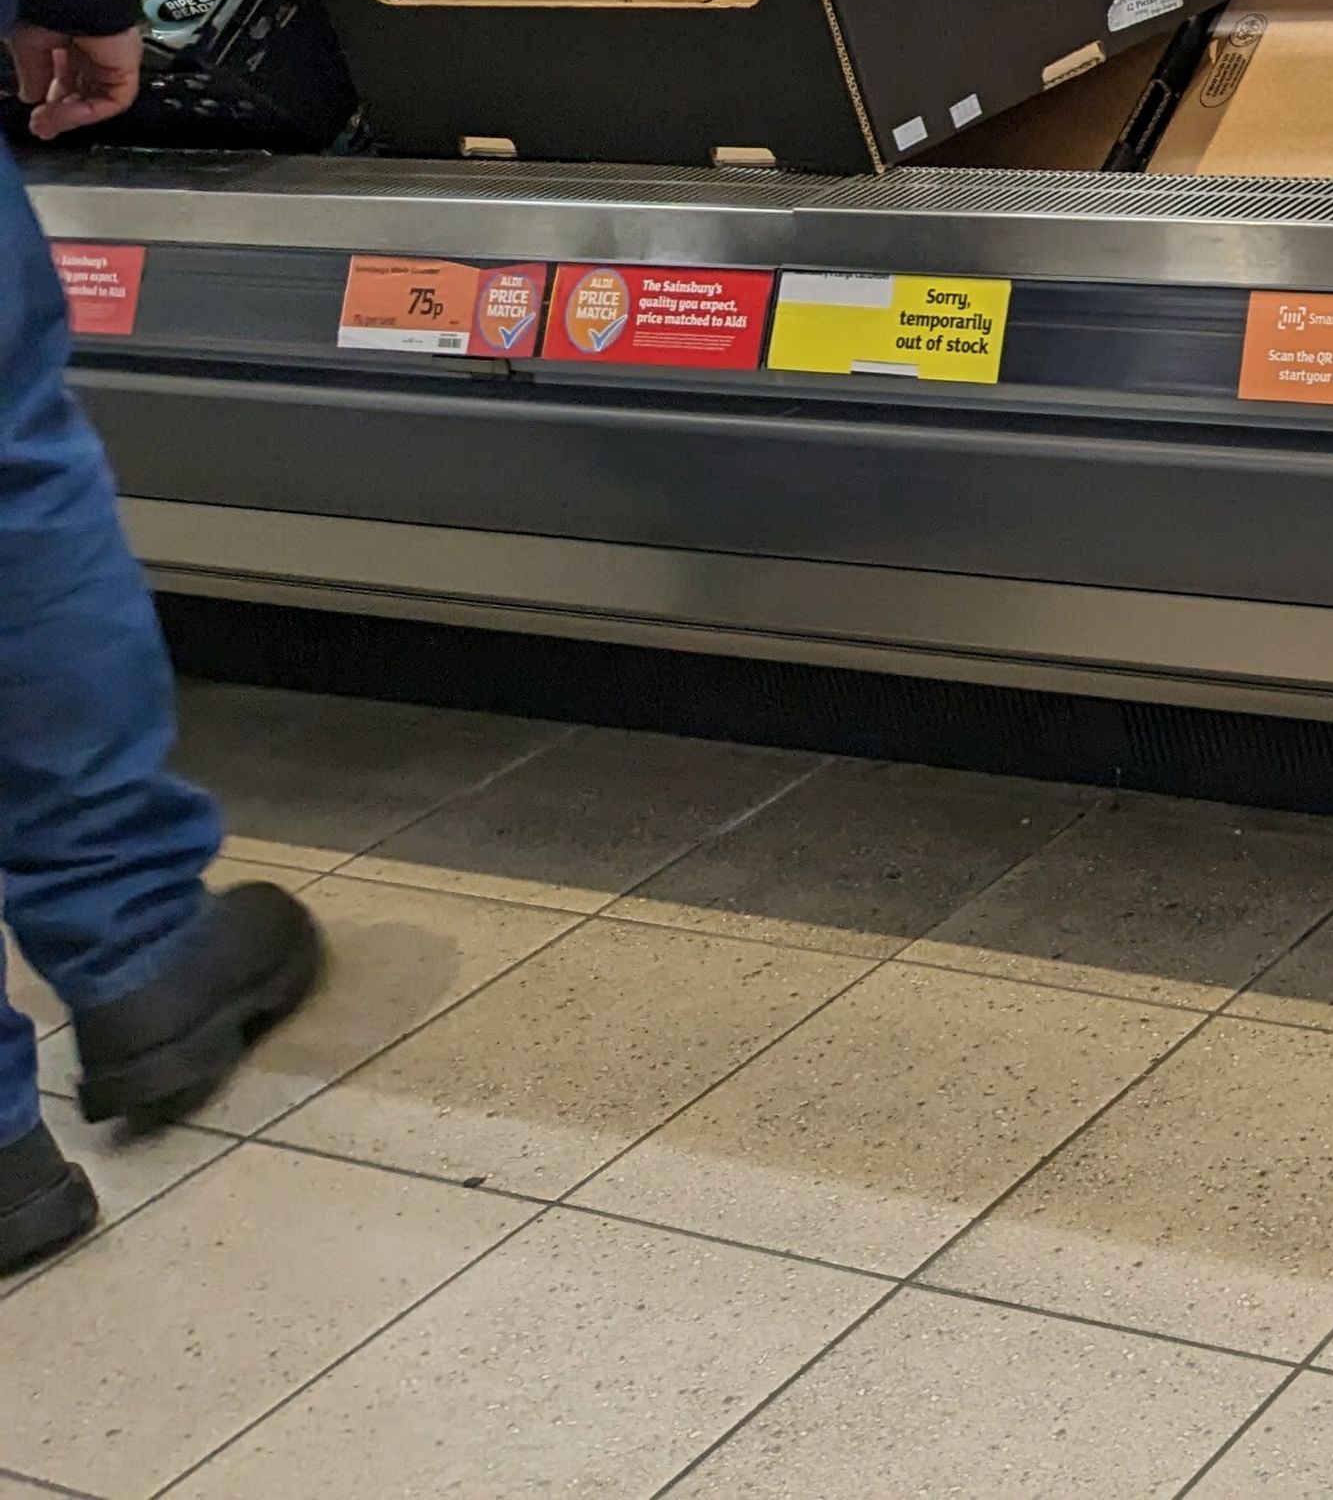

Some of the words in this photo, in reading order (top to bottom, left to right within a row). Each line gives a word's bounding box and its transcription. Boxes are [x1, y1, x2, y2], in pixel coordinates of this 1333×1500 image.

[501, 276, 523, 286] ALDI
[590, 278, 613, 288] ALDI
[643, 280, 660, 291] The
[663, 281, 723, 297] Sainsbury's
[408, 288, 443, 319] 75p
[489, 289, 529, 304] PRICE
[578, 291, 621, 306] PRICE
[926, 289, 971, 310] Sorry,
[487, 304, 526, 317] MATCH
[639, 297, 677, 310] quality
[678, 300, 698, 310] you
[700, 300, 737, 312] expect,
[576, 307, 617, 319] MATCH
[636, 313, 662, 325] price
[665, 314, 710, 326] matched
[725, 316, 747, 328] Aldi
[900, 311, 992, 334] temporarily
[896, 336, 922, 350] out
[926, 335, 943, 351] of
[946, 337, 989, 354] stock
[1267, 350, 1295, 362] Scan
[1297, 351, 1314, 362] the
[1317, 351, 1333, 365] QR
[1279, 370, 1306, 381] start
[1307, 371, 1331, 384] your
